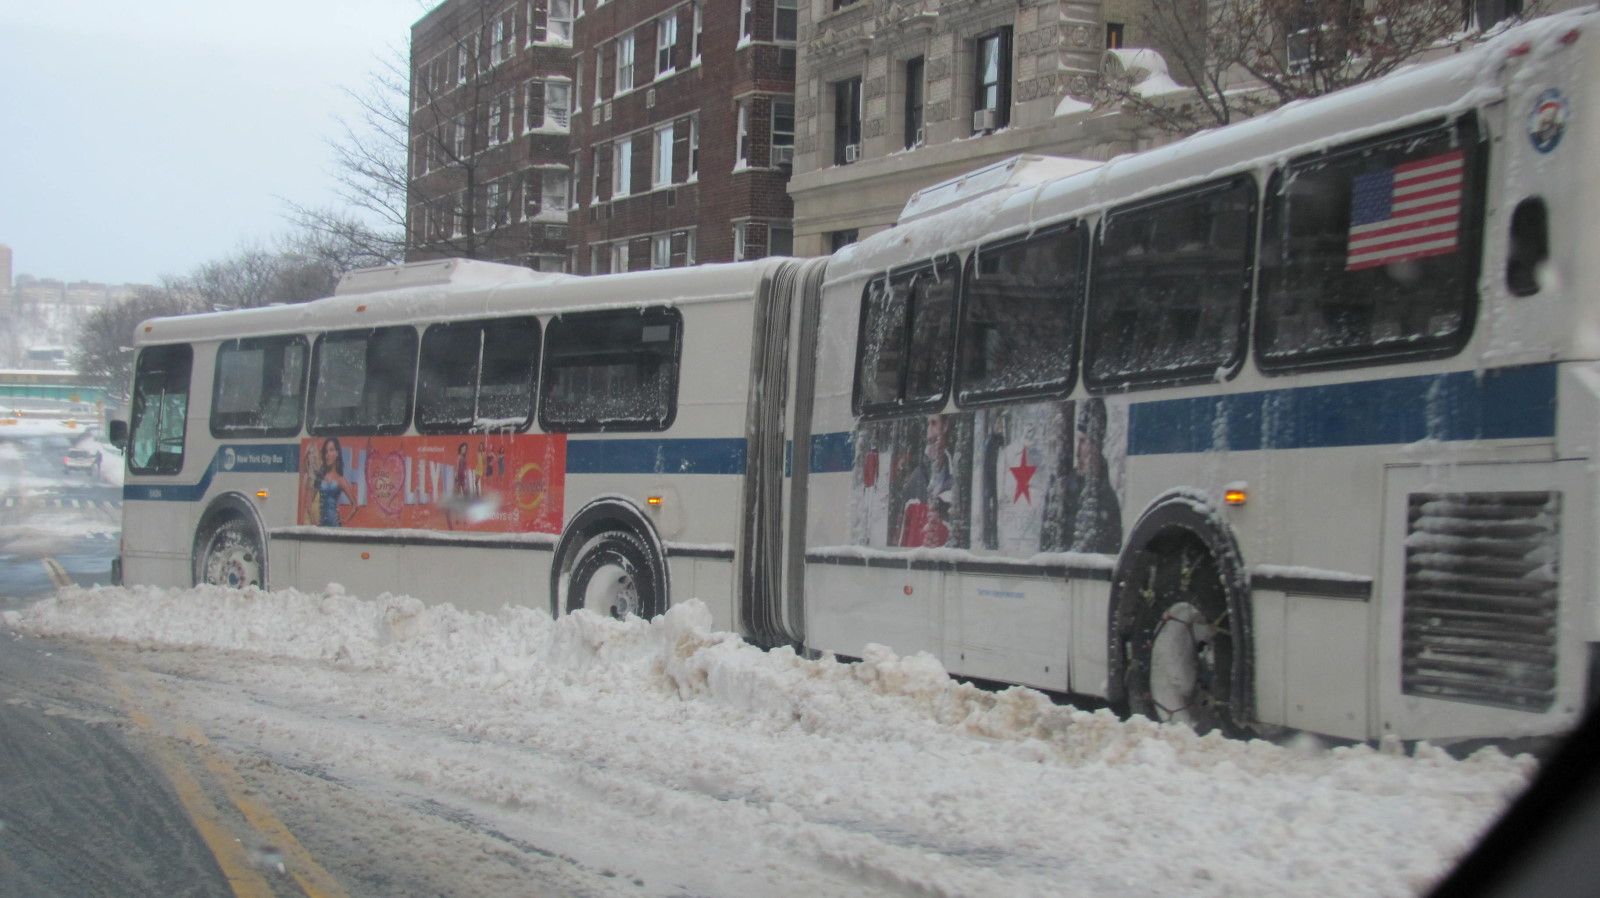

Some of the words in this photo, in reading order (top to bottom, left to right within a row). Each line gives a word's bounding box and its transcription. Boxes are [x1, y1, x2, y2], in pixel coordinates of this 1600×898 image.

[237, 454, 248, 464] New
[249, 454, 261, 464] York
[261, 454, 272, 465] City
[272, 454, 283, 464] Bus
